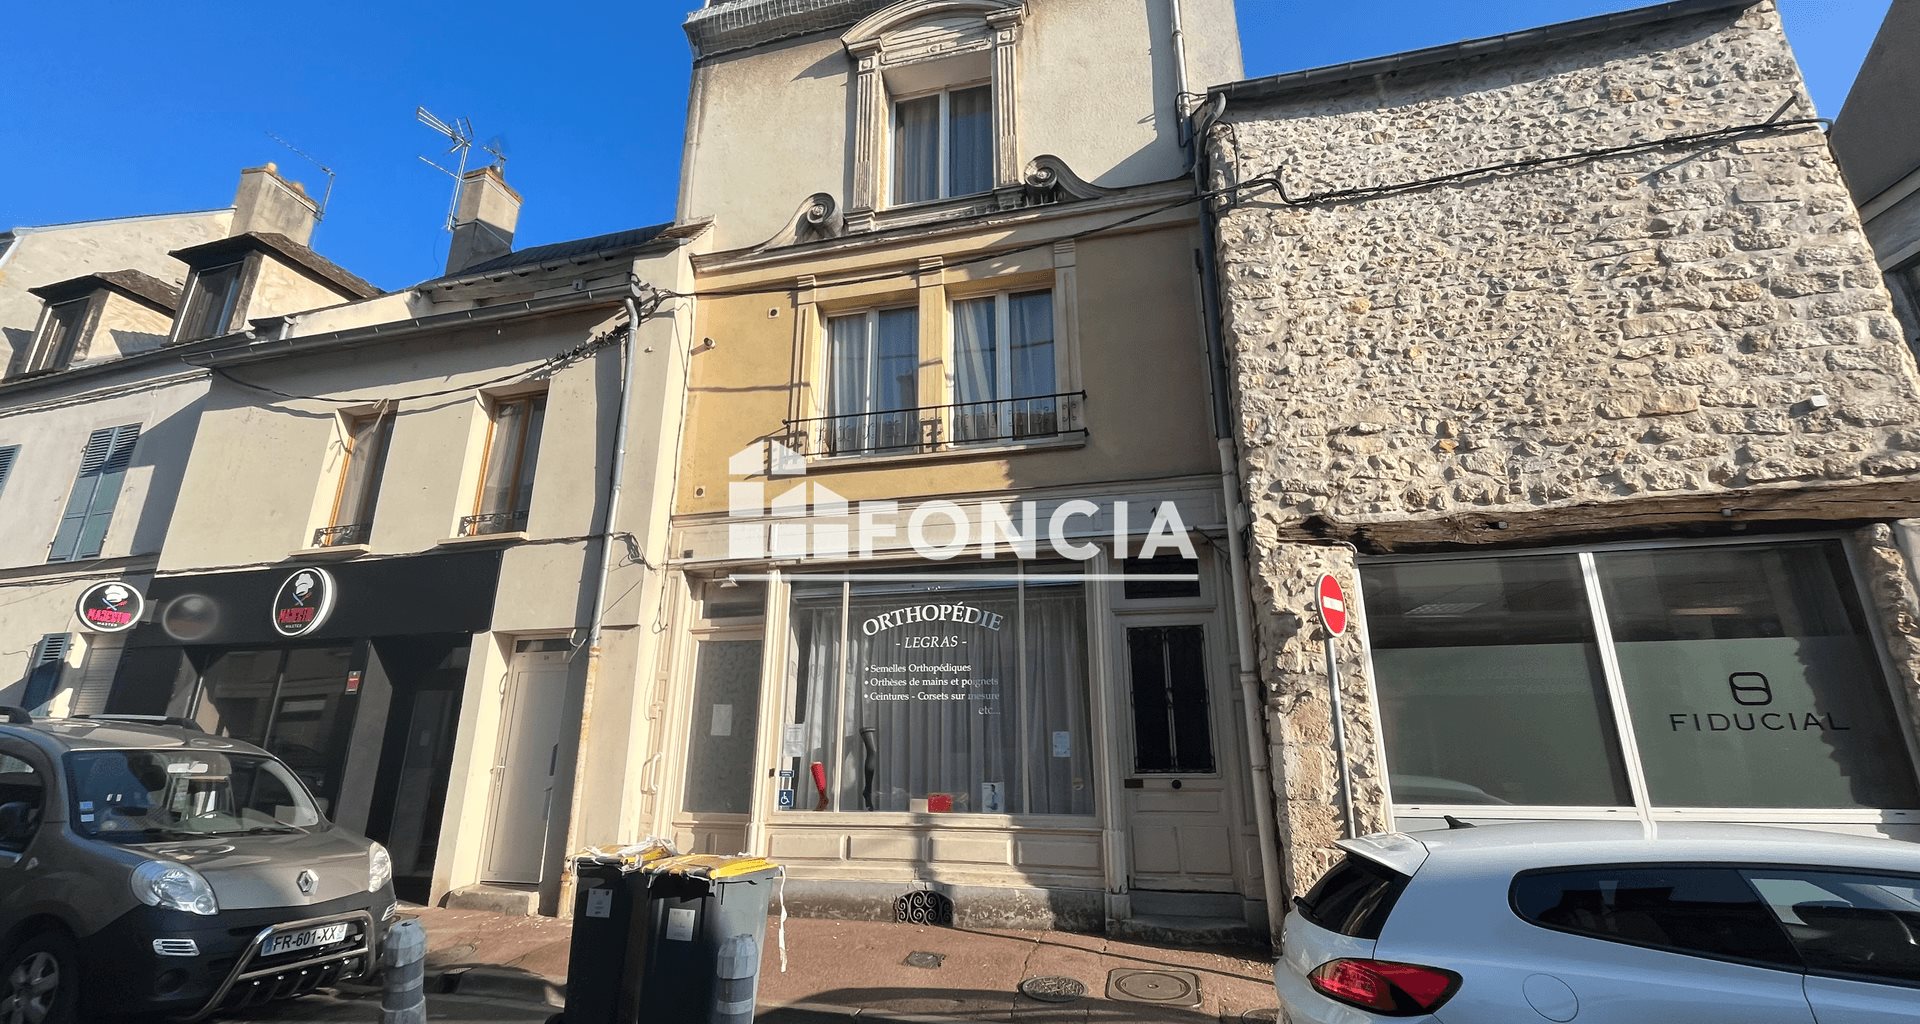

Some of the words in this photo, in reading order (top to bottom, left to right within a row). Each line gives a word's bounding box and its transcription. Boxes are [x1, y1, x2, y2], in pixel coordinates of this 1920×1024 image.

[862, 601, 1004, 636] ORTHOPÉDIE
[904, 635, 959, 649] LEGRAS
[870, 664, 907, 673] Semelles
[908, 663, 972, 675] Orthopédiques
[870, 677, 907, 687] Orthèses
[909, 677, 920, 686] de
[922, 677, 949, 686] mains
[950, 678, 959, 686] et
[961, 677, 999, 688] poignets
[869, 692, 910, 701] Ceintures
[917, 691, 949, 701] Corsets
[967, 692, 1000, 700] mesure
[1669, 712, 1851, 732] FIDUCIAL
[272, 925, 337, 952] FR-601-XX
